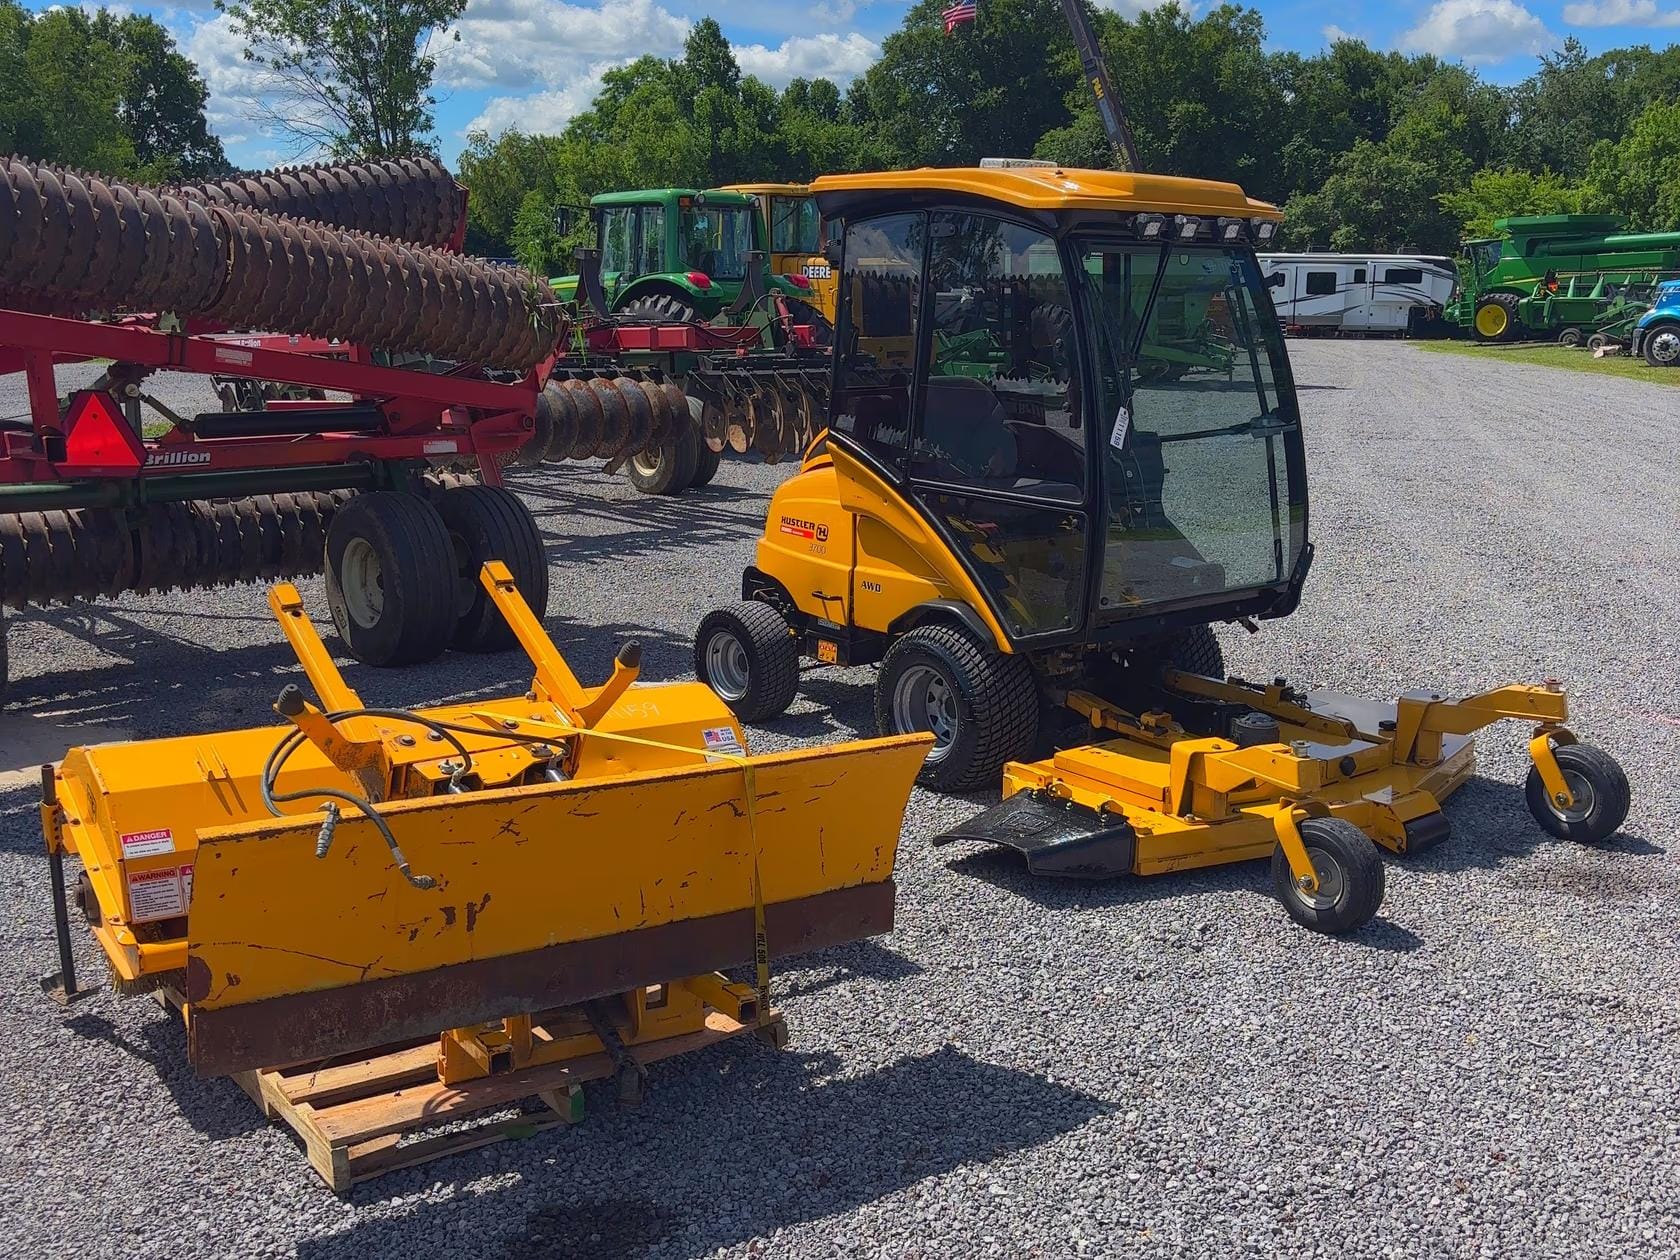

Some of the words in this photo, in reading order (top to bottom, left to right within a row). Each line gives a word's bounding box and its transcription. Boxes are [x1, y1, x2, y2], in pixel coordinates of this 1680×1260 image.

[802, 265, 831, 279] DEERE
[781, 515, 816, 531] HUSTLER
[861, 580, 881, 593] AWD
[133, 831, 167, 842] DANGER
[137, 869, 176, 881] WARNING
